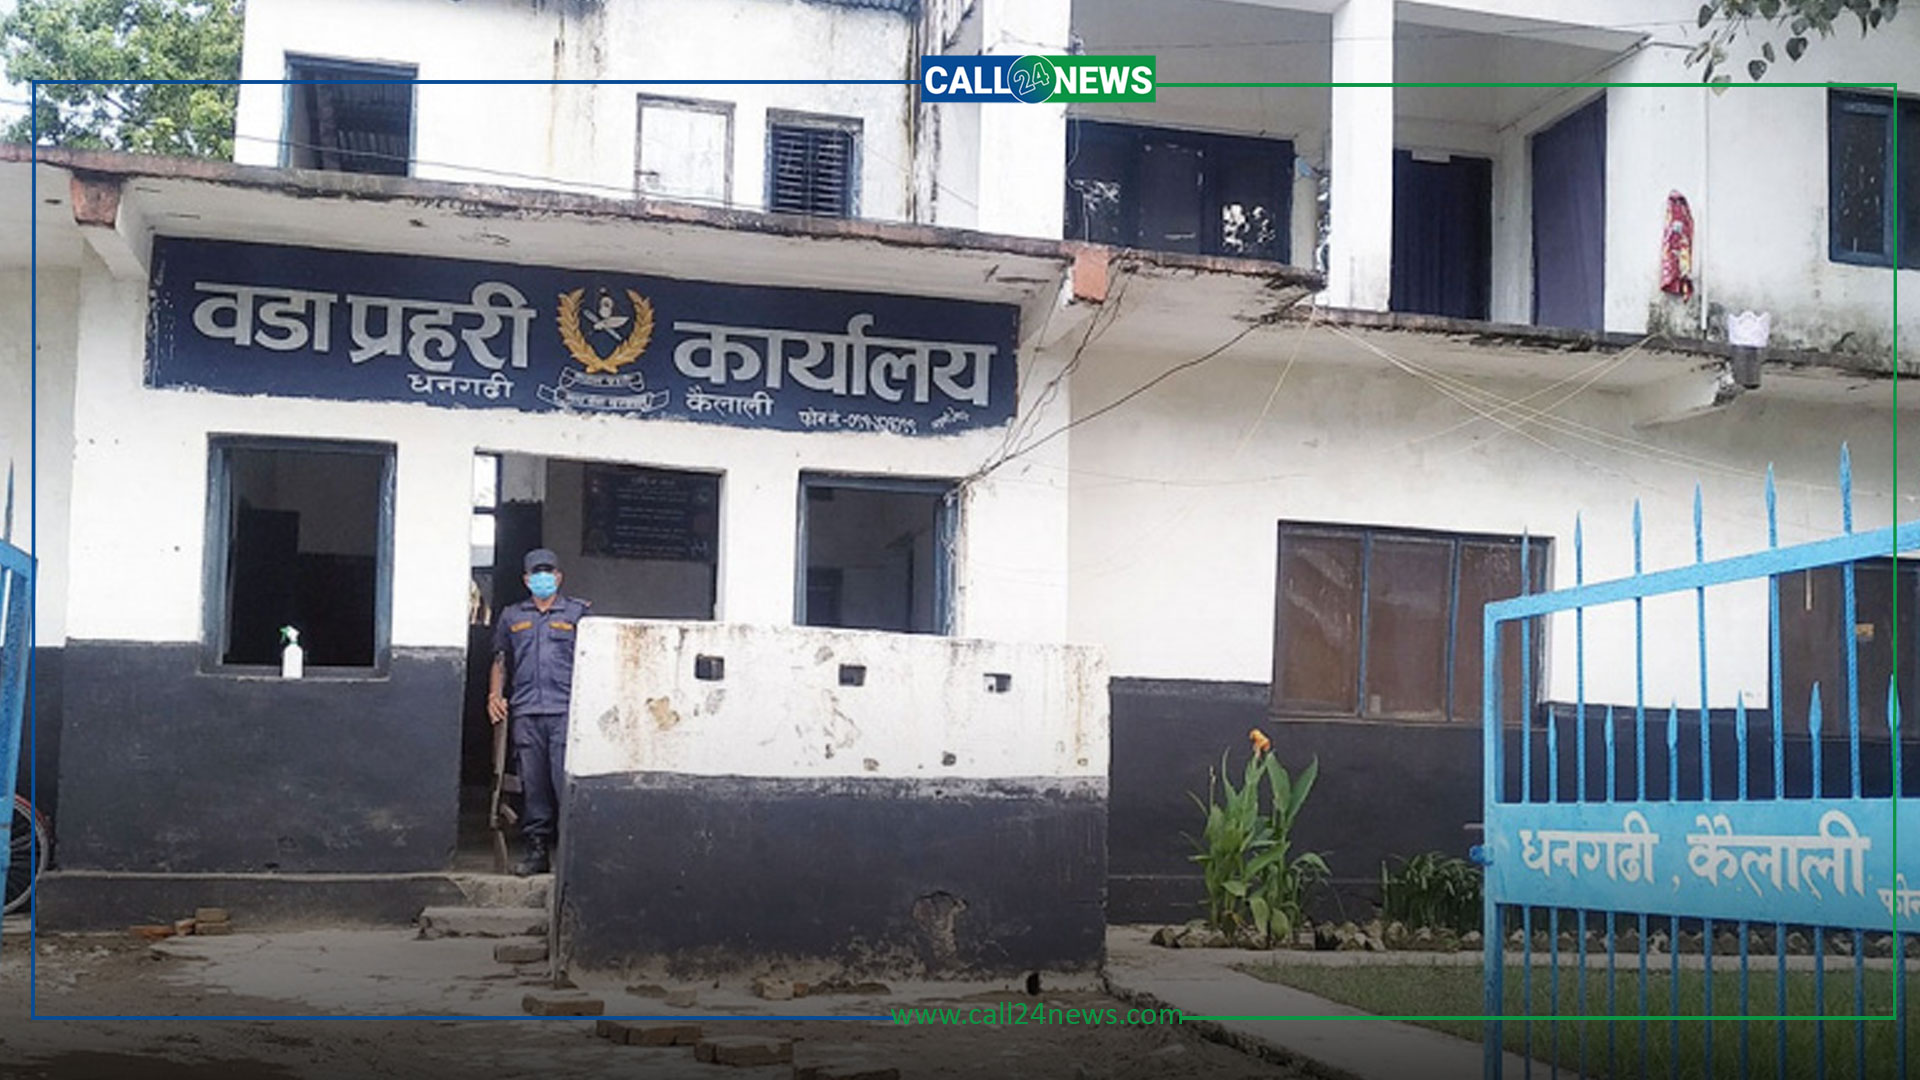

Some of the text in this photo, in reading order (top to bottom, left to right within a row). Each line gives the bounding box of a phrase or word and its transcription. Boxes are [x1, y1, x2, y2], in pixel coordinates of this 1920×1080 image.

[192, 281, 997, 406] वडा प्रहरी कार्यालय
[406, 371, 514, 398] धनगढी
[685, 384, 774, 420] कैलाली
[1686, 809, 1871, 900] कैलाली
